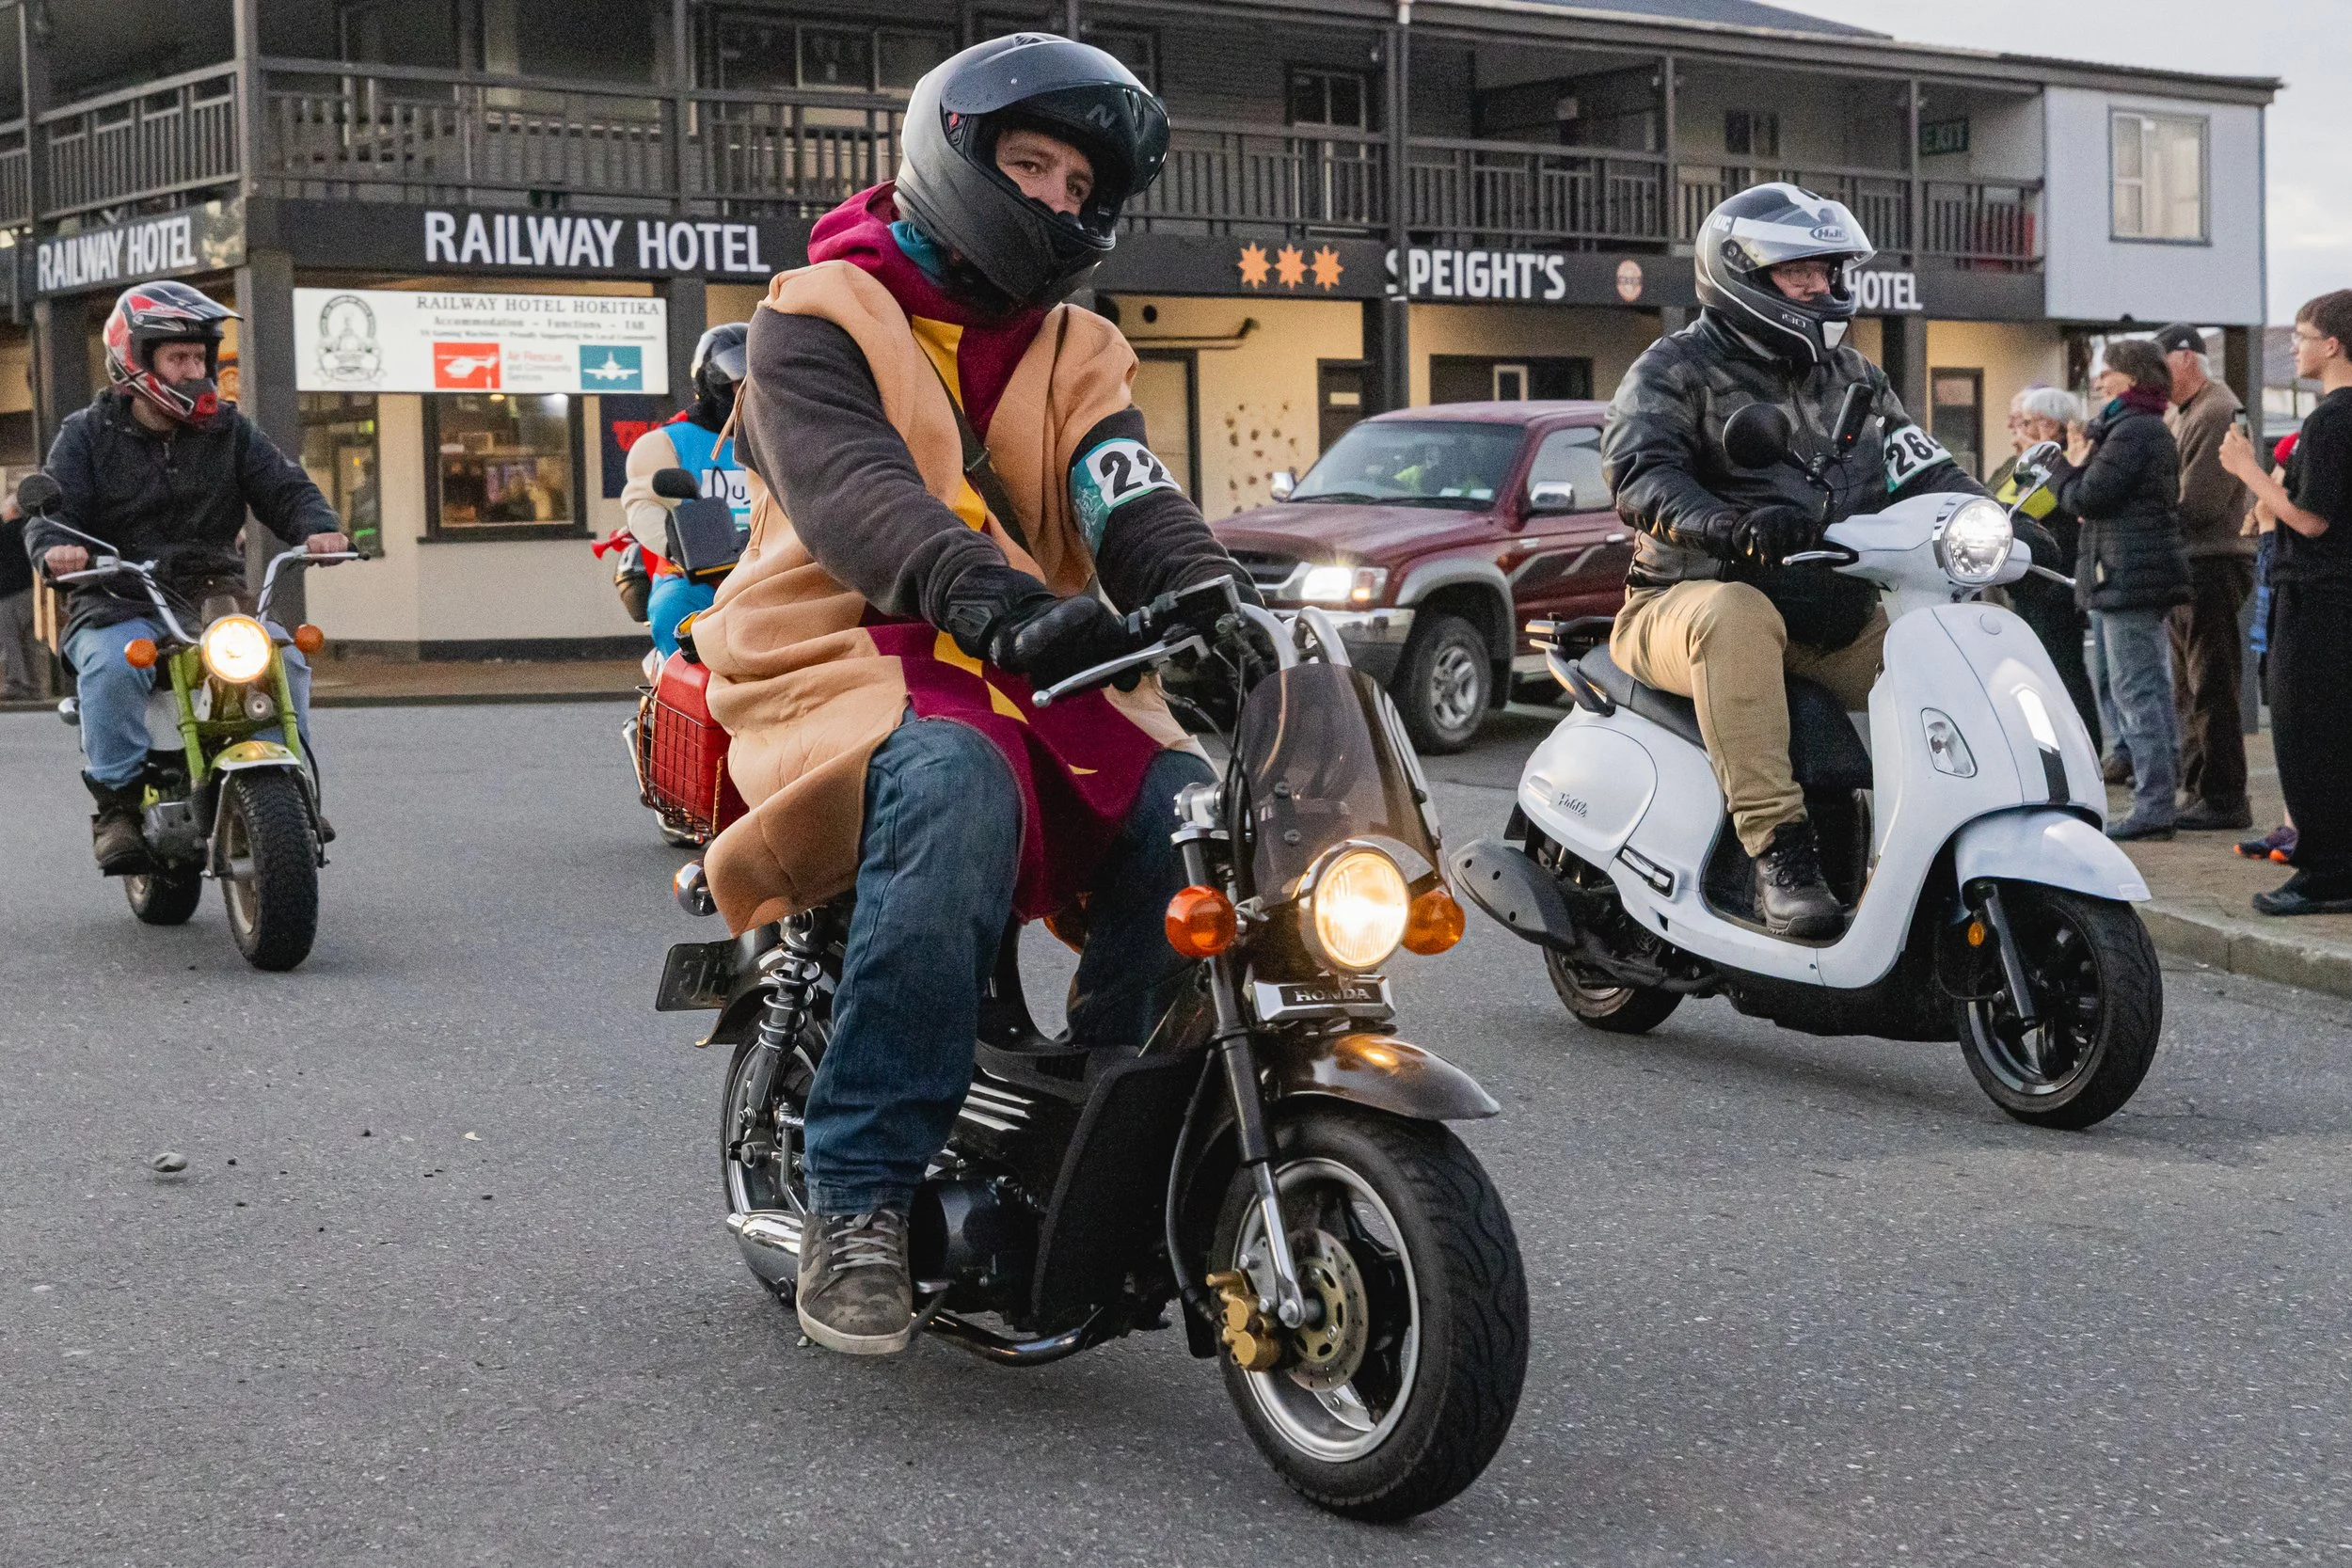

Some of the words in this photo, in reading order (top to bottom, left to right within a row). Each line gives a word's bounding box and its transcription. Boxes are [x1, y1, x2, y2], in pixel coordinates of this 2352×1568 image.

[424, 211, 623, 267] RAILWAY
[637, 220, 771, 273] HOTEL
[37, 229, 124, 293] RAILWAY
[126, 215, 198, 276] HOTEL
[1845, 271, 1923, 310] HOTEL
[417, 296, 497, 311] RAILWAY
[505, 299, 565, 313] HOTEL
[573, 301, 660, 315] HOKITIKA
[434, 316, 524, 326] Accommodation
[523, 351, 564, 363] Rescue
[1295, 987, 1372, 1003] HONDA
